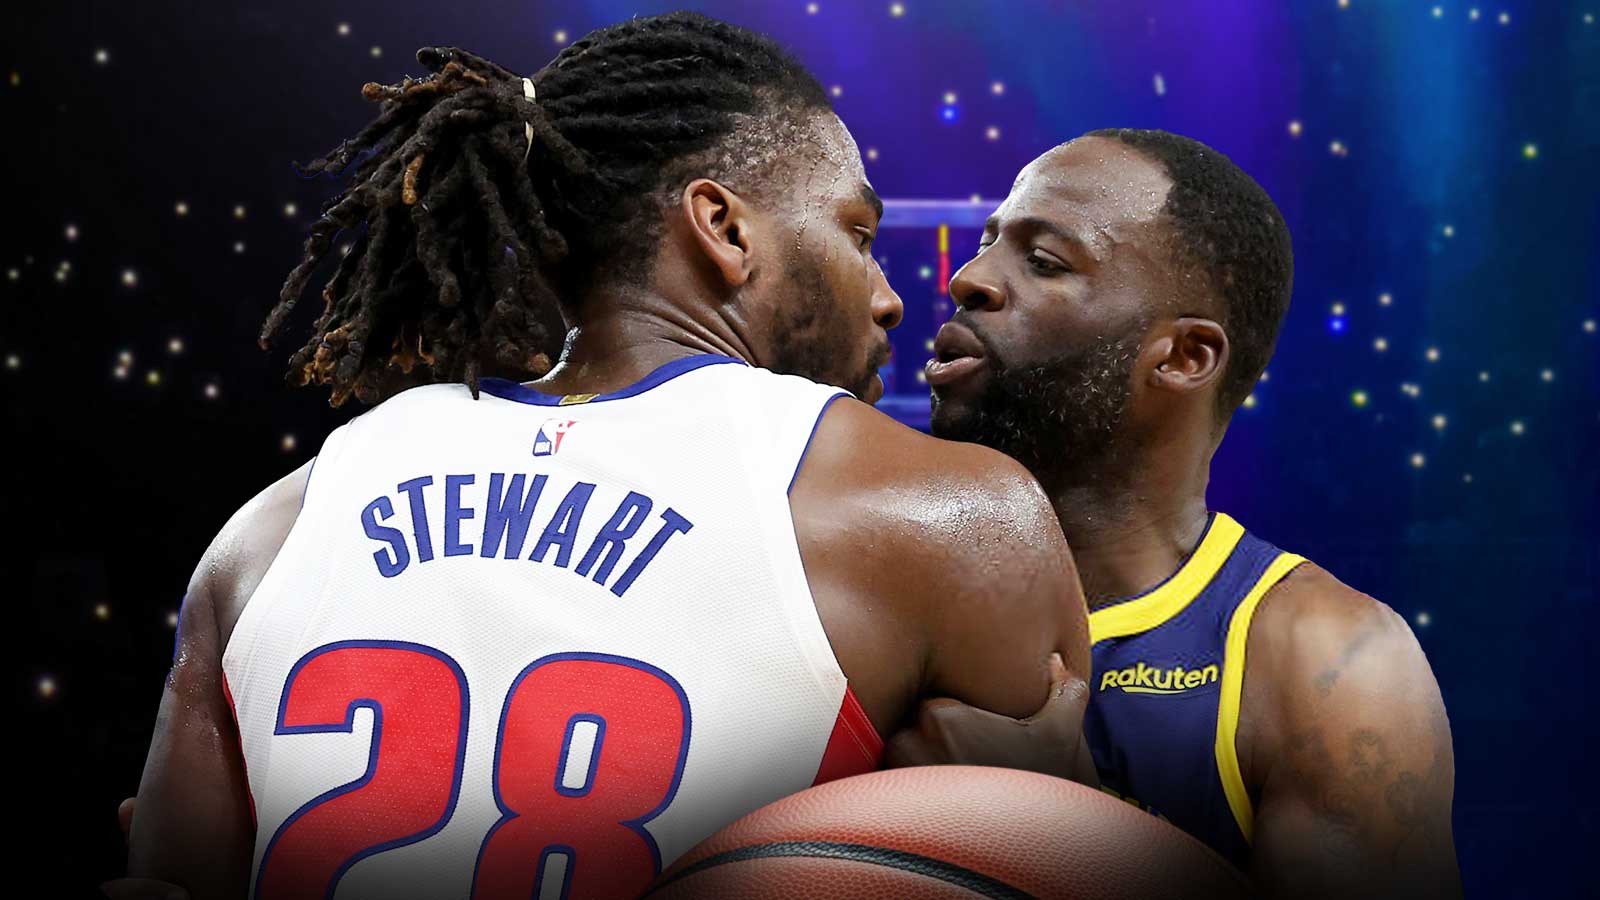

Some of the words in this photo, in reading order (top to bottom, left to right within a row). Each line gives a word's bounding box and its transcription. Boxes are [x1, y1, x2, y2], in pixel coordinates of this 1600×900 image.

[361, 473, 693, 597] STEWART
[1100, 662, 1220, 692] Rakuten
[254, 639, 692, 900] 28
